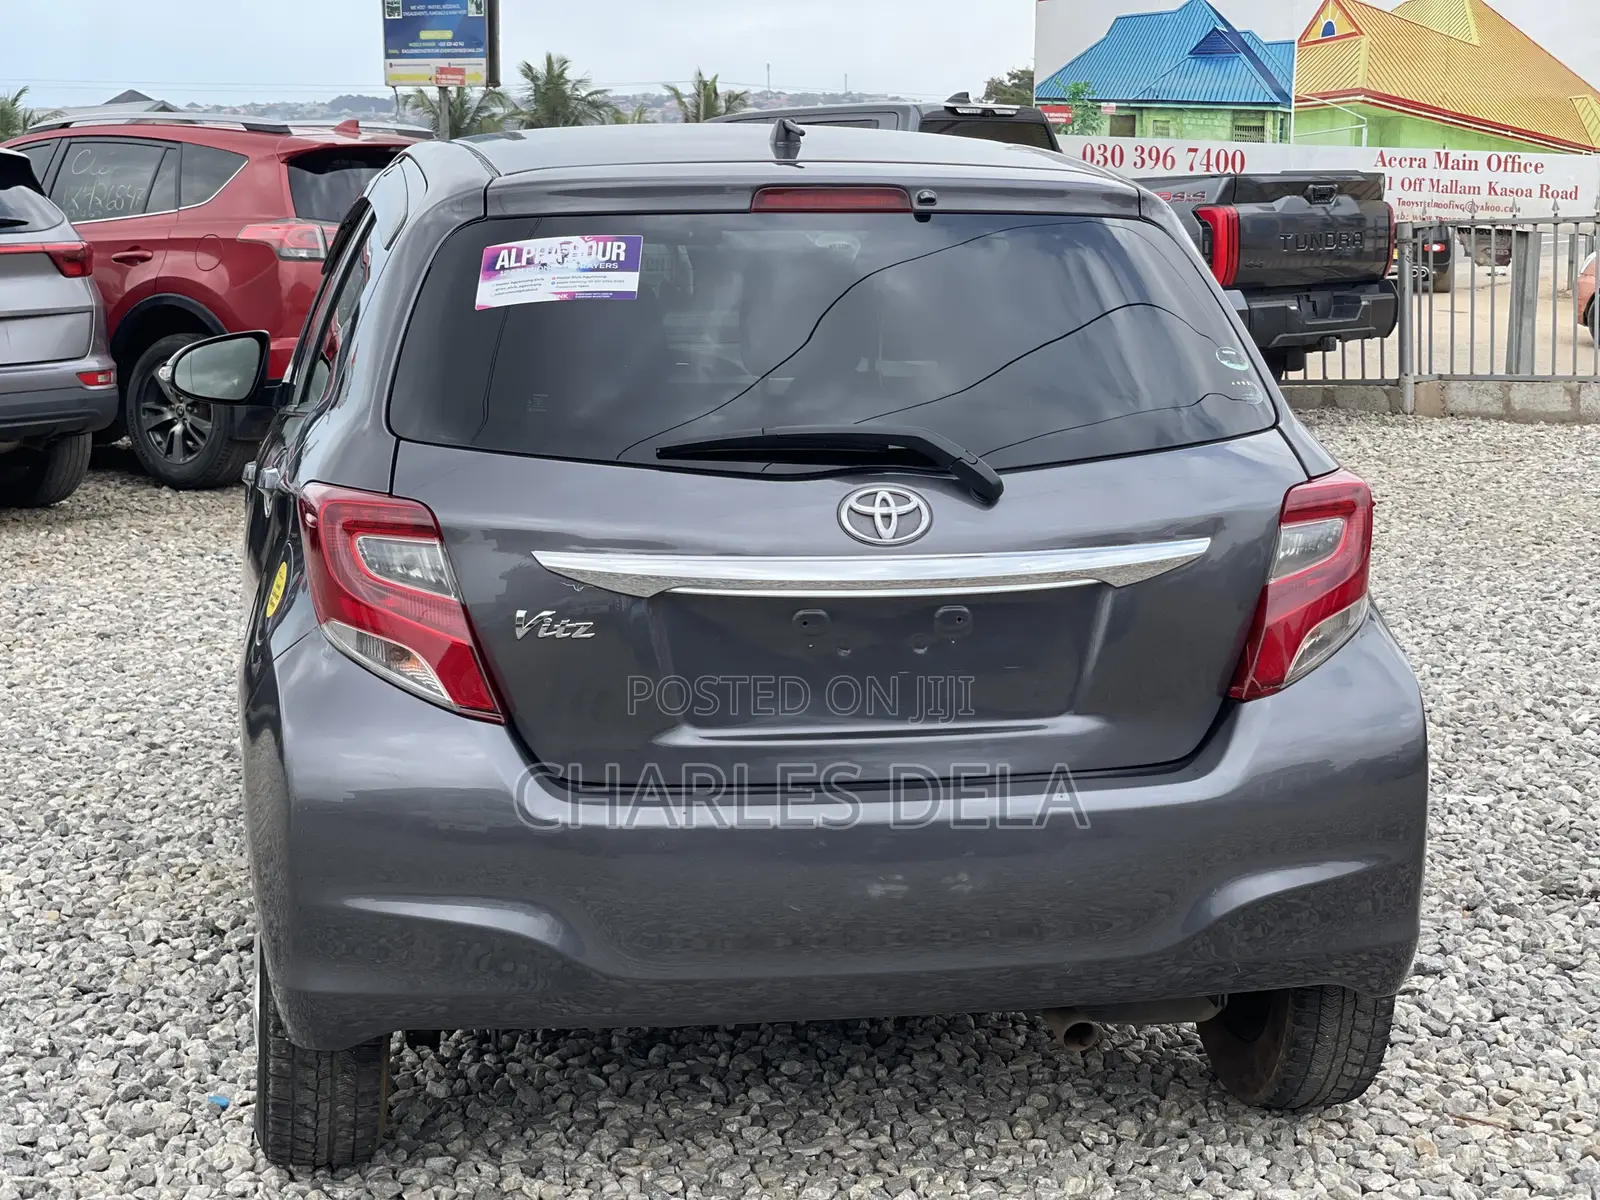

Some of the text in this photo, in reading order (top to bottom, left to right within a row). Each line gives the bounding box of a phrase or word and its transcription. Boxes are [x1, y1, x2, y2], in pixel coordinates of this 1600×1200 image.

[1081, 143, 1246, 175] 030 396 7400
[1374, 149, 1545, 174] Accra Main Office
[1400, 176, 1425, 192] Off
[1428, 178, 1481, 196] Mallam
[1487, 181, 1533, 198] Kasoa
[1539, 184, 1579, 200] Road
[1279, 232, 1364, 252] TUNDRA
[515, 609, 596, 640] Vitz
